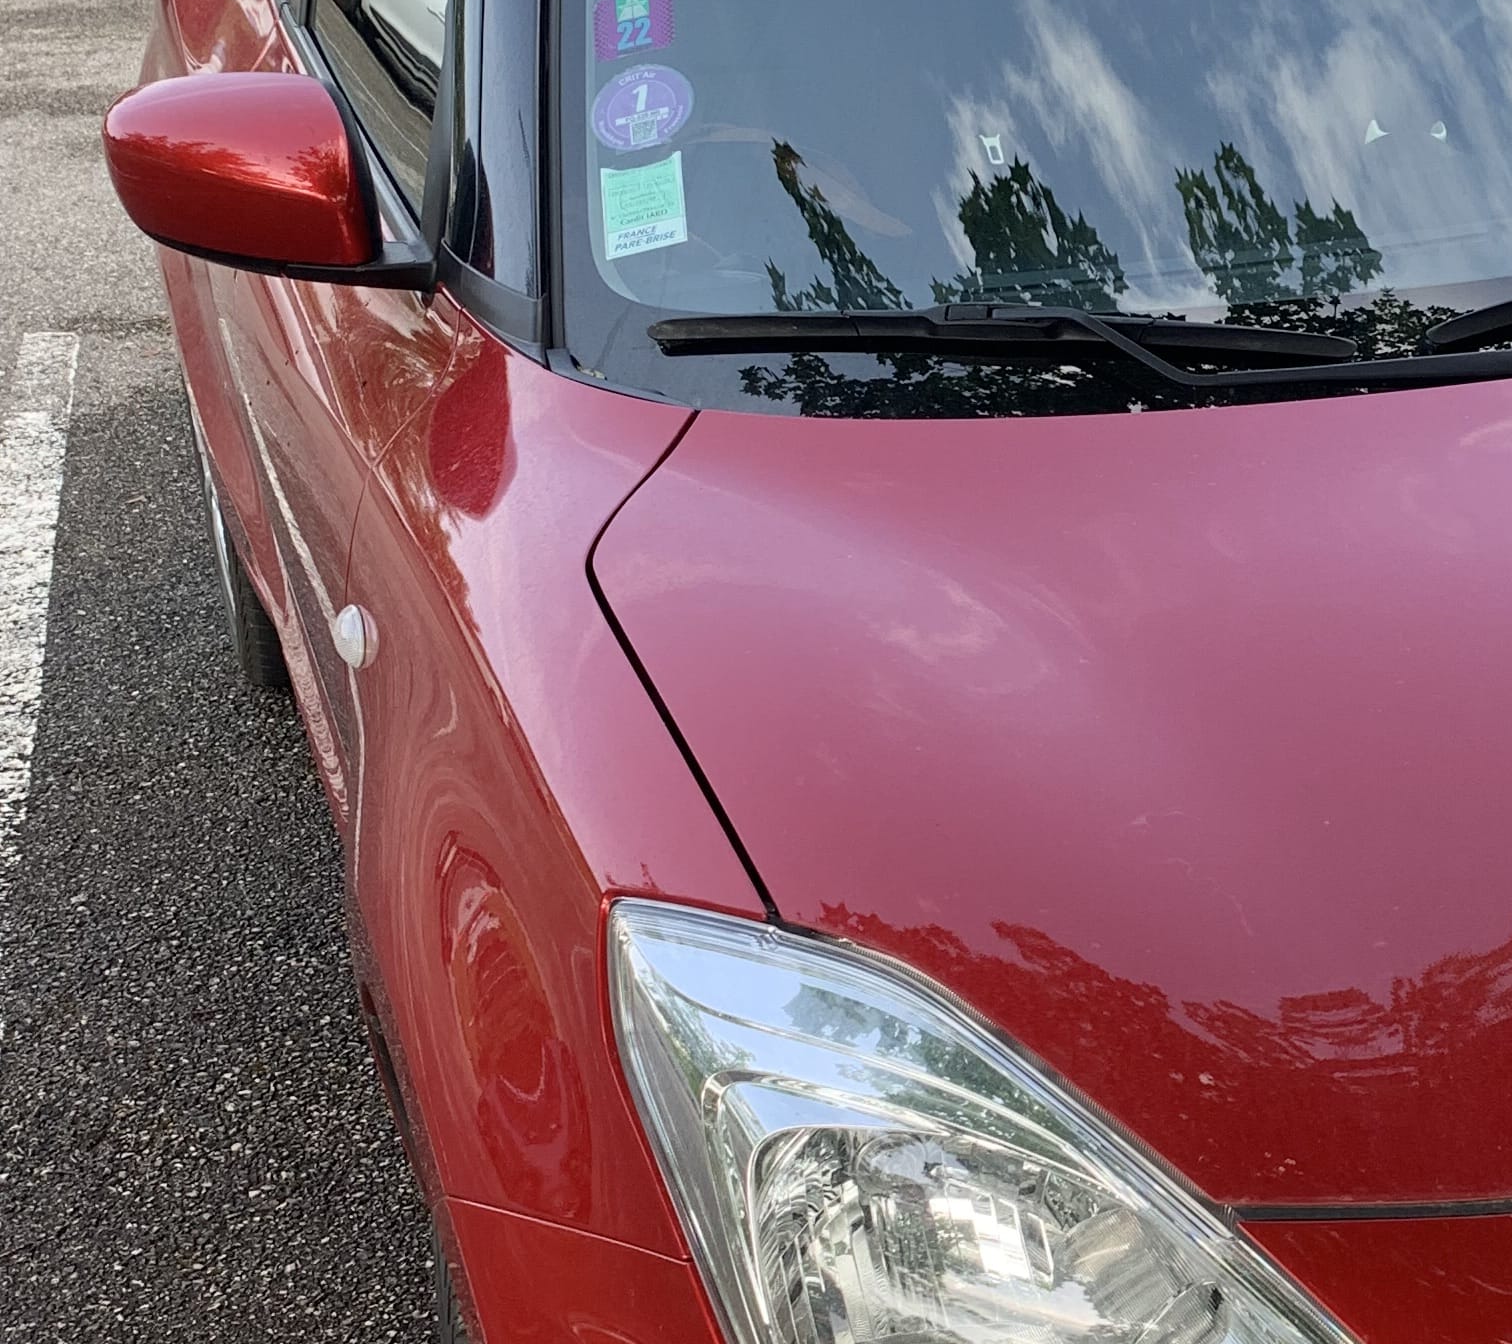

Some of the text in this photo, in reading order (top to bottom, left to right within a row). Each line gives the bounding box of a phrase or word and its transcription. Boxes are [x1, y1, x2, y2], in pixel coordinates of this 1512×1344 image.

[617, 17, 653, 51] 22
[632, 83, 648, 113] 1
[617, 225, 656, 241] FRANCE
